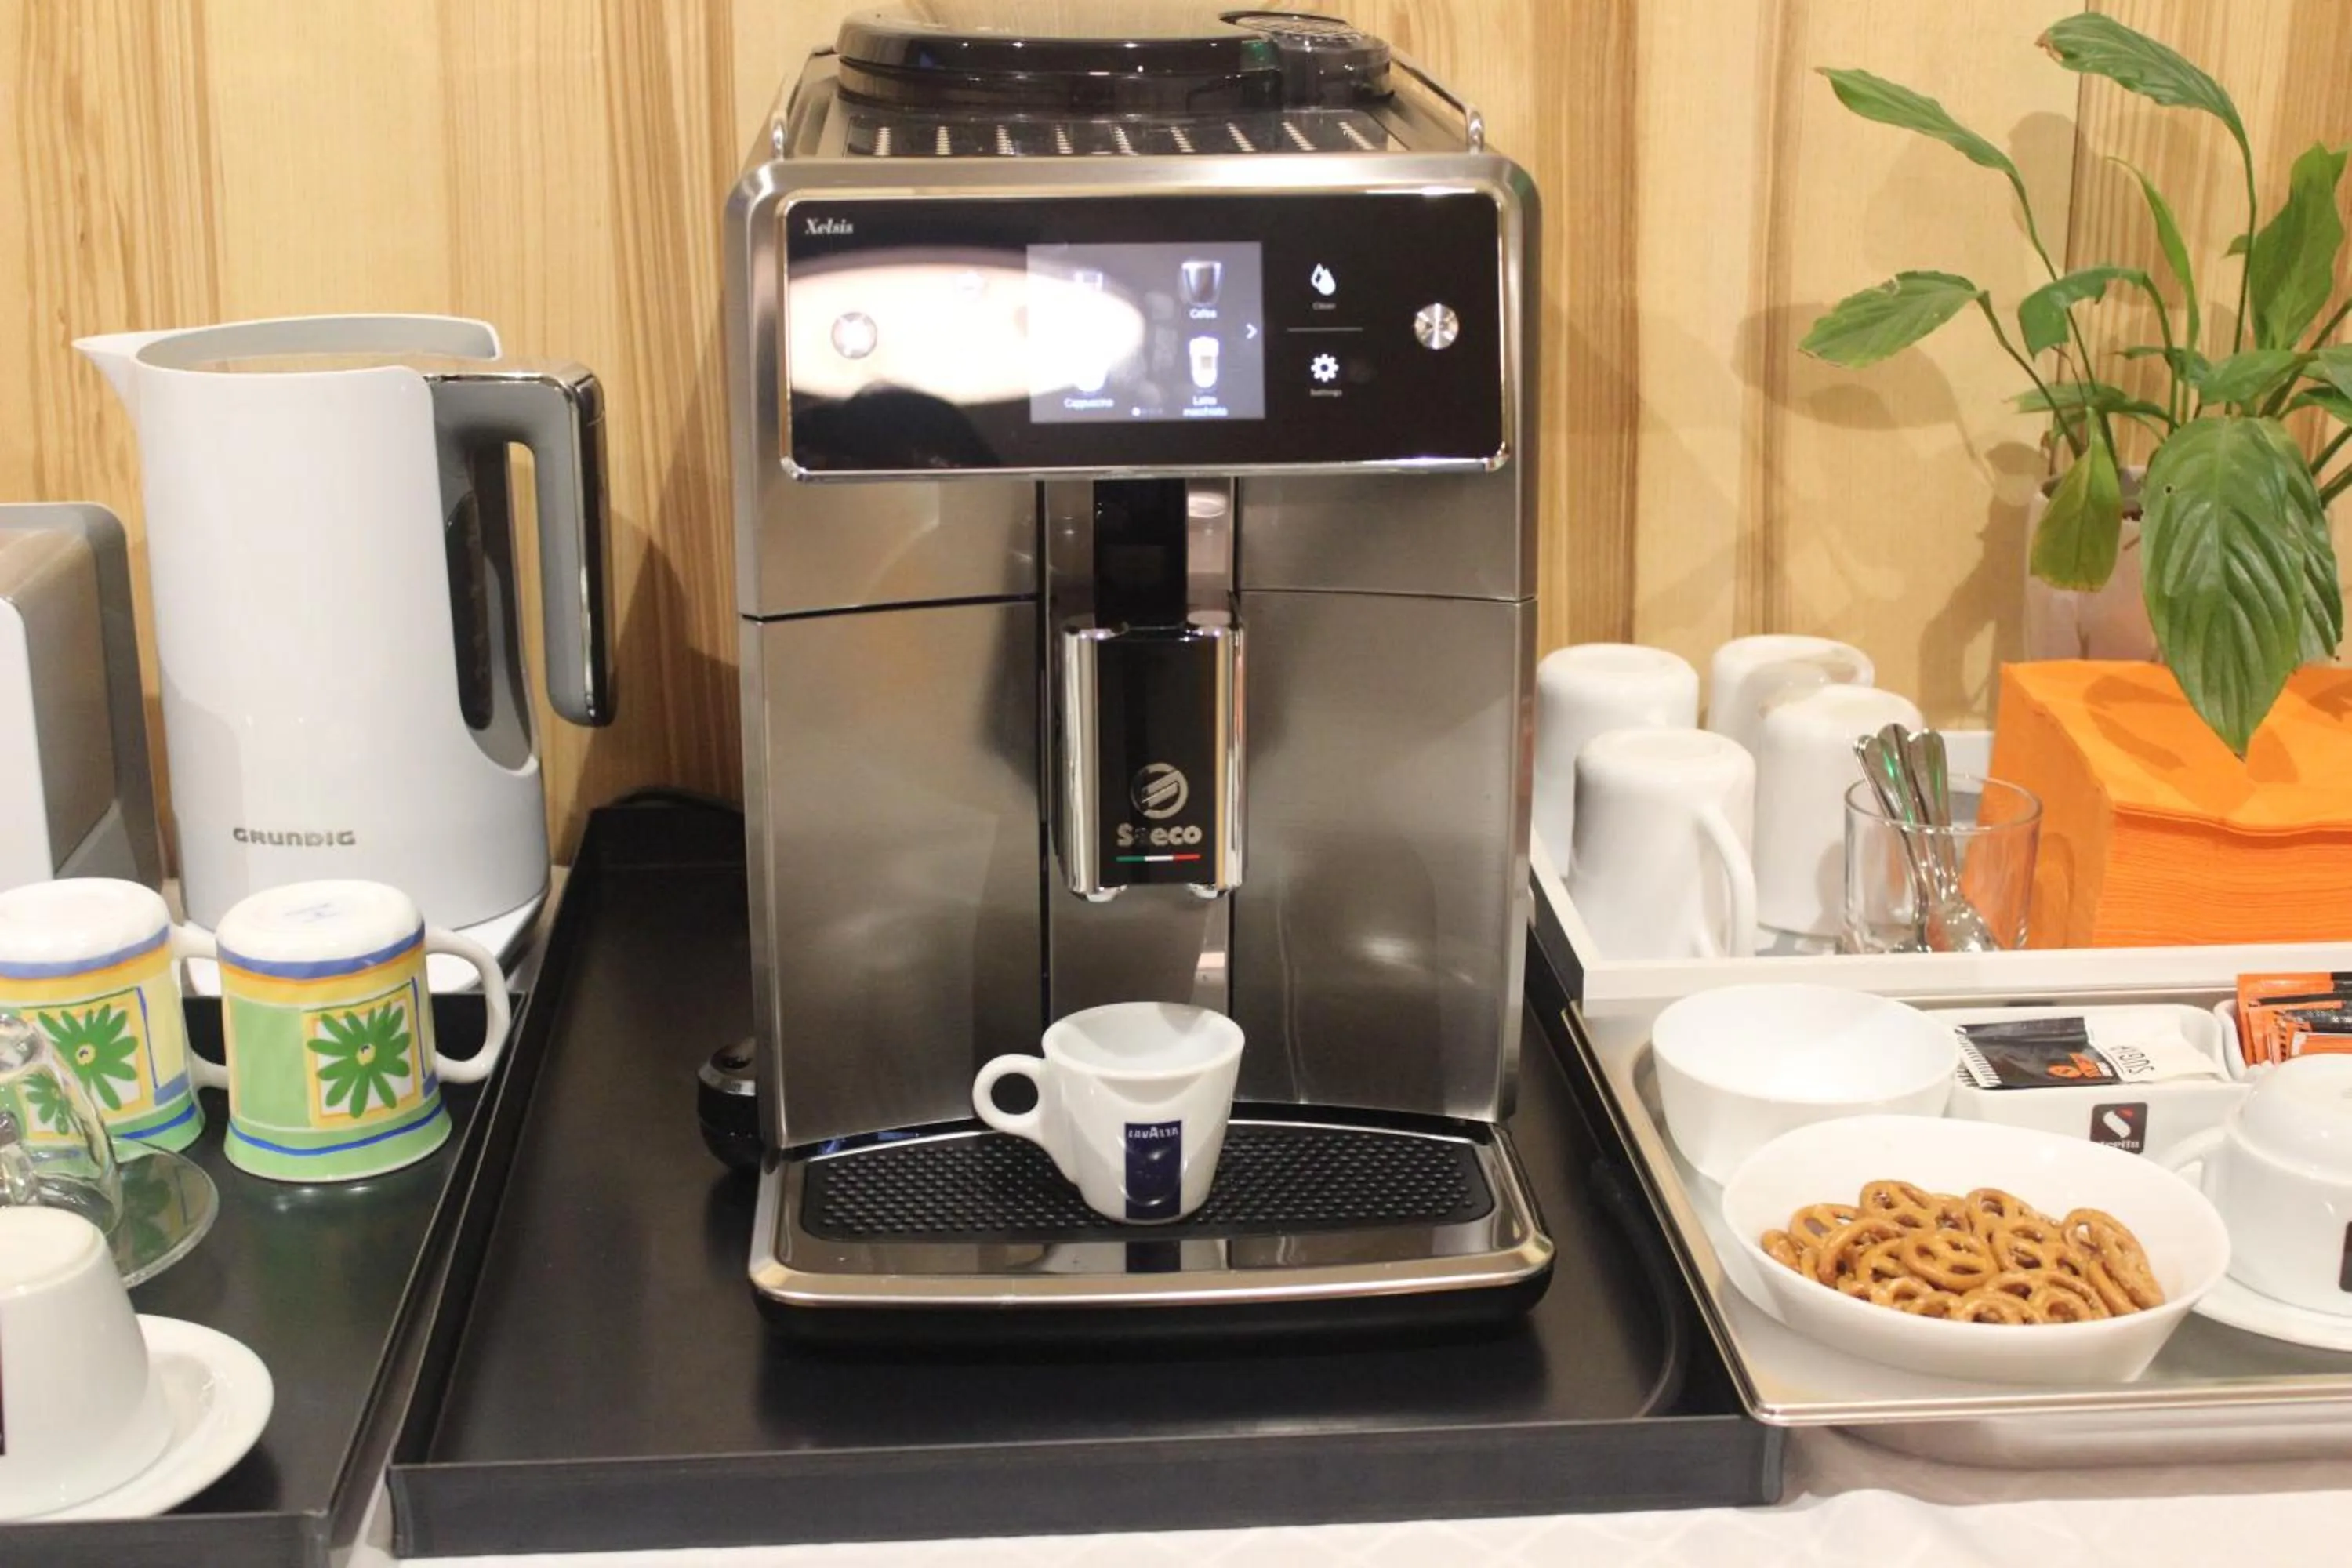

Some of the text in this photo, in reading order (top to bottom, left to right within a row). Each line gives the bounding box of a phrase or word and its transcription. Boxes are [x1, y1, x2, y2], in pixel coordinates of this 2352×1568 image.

[804, 217, 854, 235] Xelsis
[233, 827, 356, 847] GRUNDIG
[1116, 823, 1203, 847] Seco
